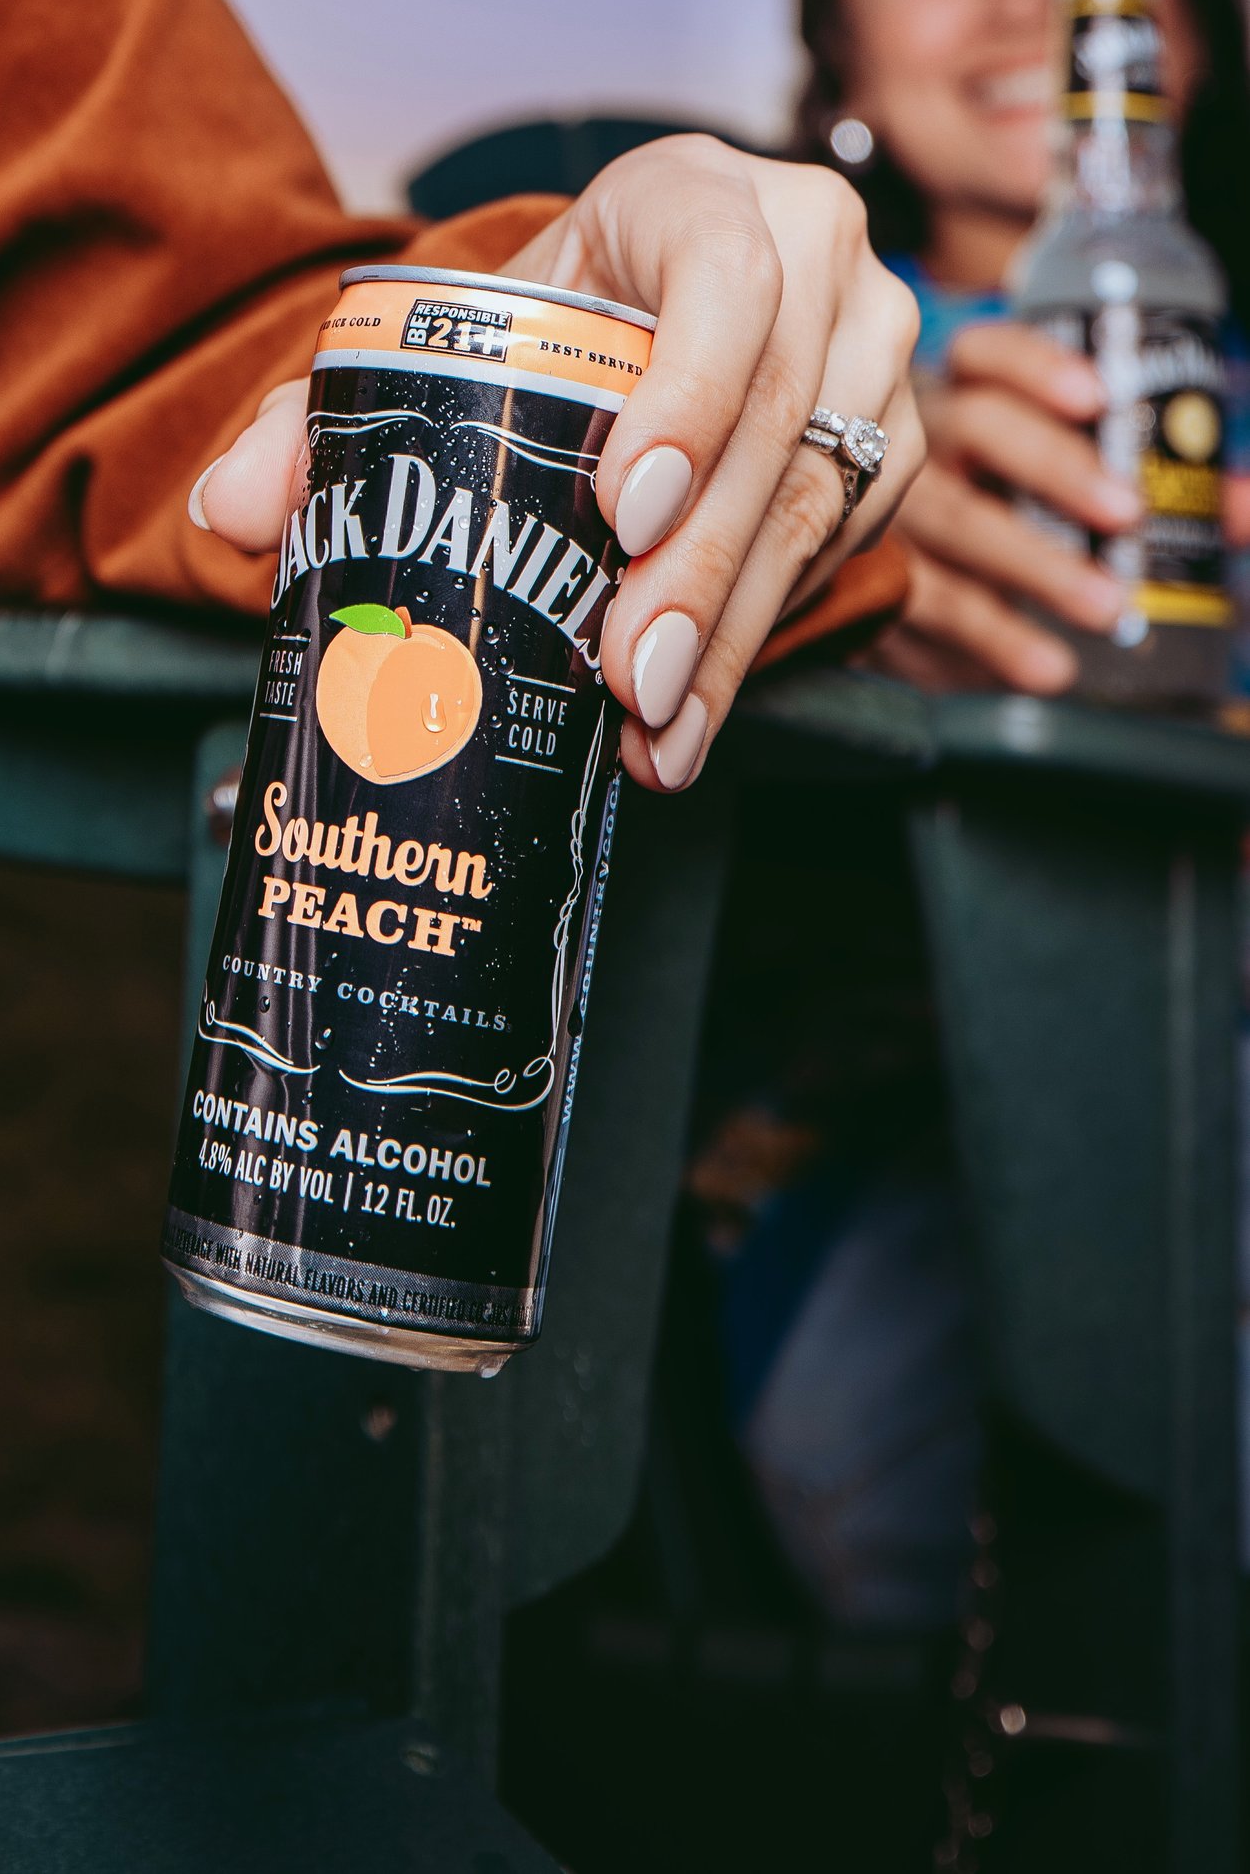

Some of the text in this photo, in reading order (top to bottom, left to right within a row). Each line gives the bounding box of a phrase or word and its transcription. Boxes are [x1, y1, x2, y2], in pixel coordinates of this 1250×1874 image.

[332, 318, 347, 328] ICE
[349, 317, 381, 327] COLD
[406, 315, 432, 345] BE
[415, 304, 507, 327] RESPONSIBLE
[428, 318, 508, 354] 21+
[540, 341, 643, 376] BEST SERVED
[271, 479, 370, 609] JACK
[269, 650, 303, 676] FRESH
[265, 681, 296, 706] TASTE
[507, 690, 568, 726] SERVE
[508, 723, 557, 756] COLD
[254, 781, 493, 900] Southern
[222, 955, 507, 1032] COUNTRY COCKTAILS
[192, 1090, 491, 1188] CONTAINS ALCOHOL
[198, 1138, 456, 1228] 4.8% ALC BY VOL 12 FL. OZ.
[216, 1241, 242, 1270] WITH
[245, 1252, 299, 1288] NATURAL
[304, 1268, 364, 1303] FLAVORS
[368, 1283, 398, 1309] AND
[403, 1290, 463, 1321] CERTIFIED
